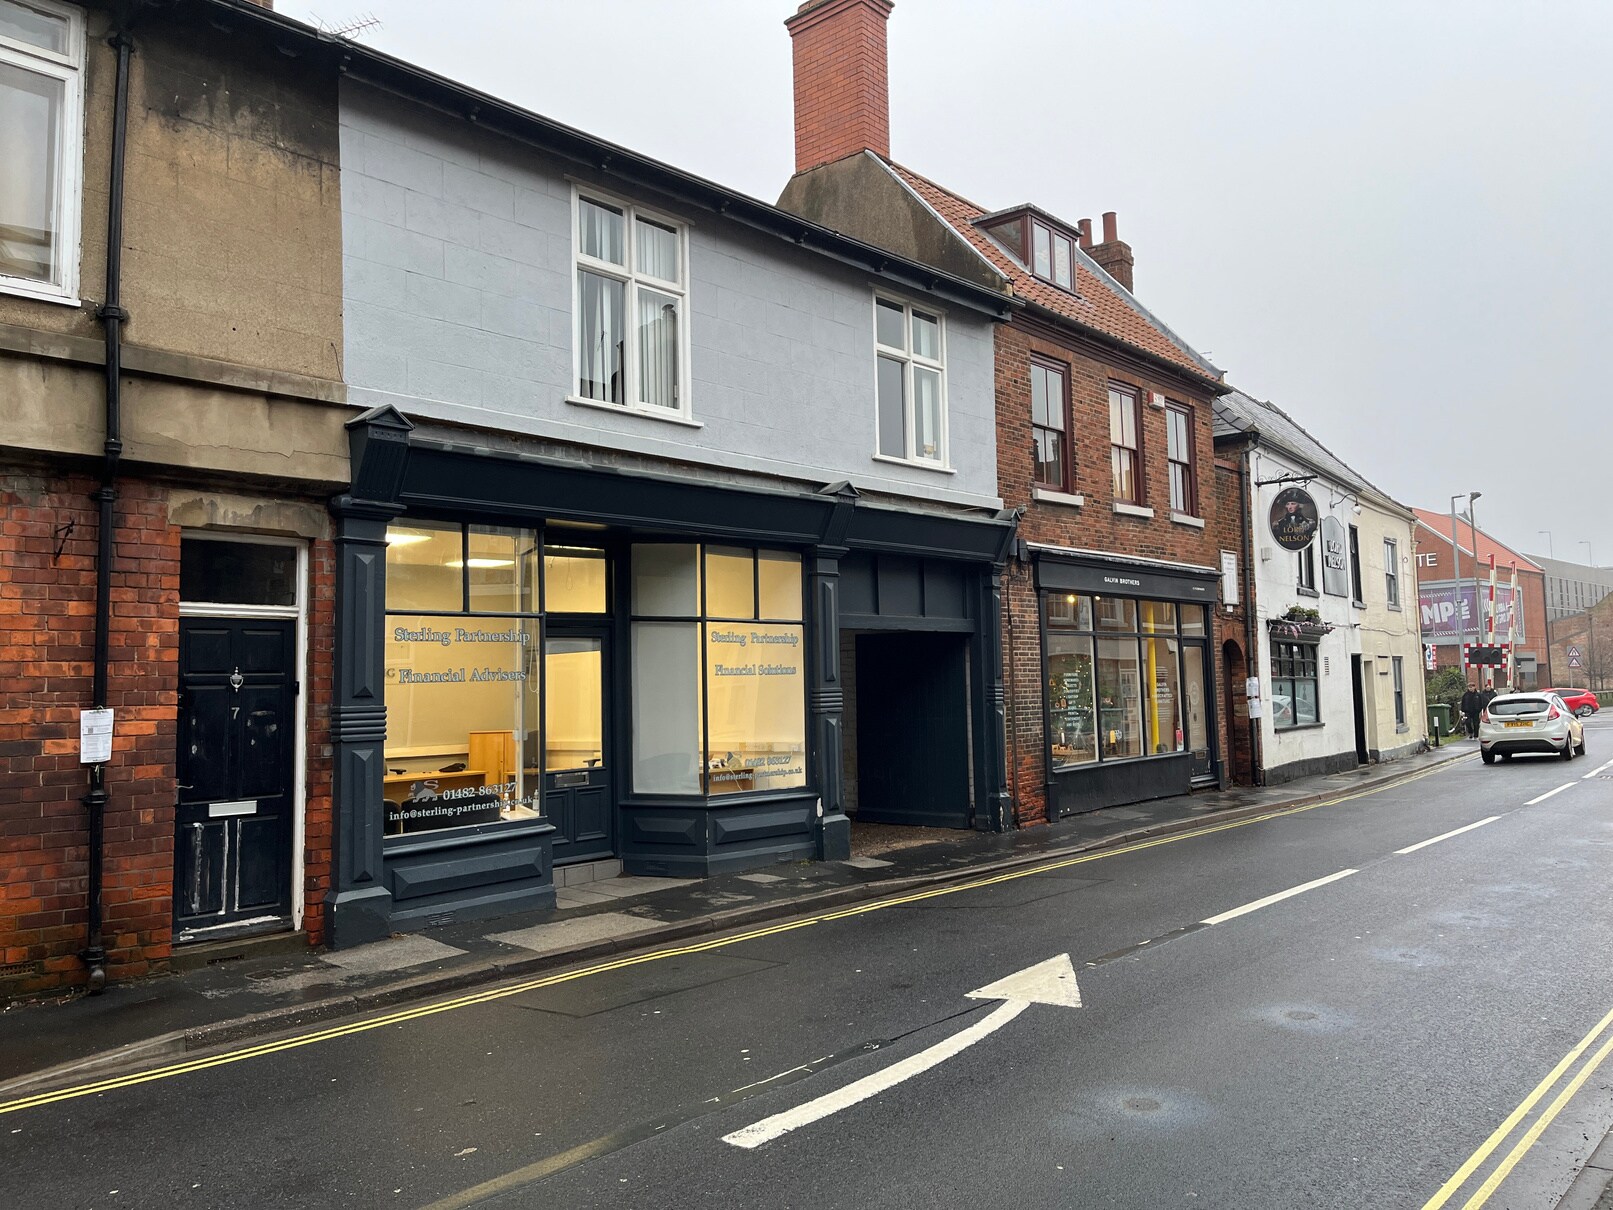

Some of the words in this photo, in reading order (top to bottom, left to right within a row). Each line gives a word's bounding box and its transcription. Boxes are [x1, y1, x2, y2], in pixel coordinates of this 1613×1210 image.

[1104, 576, 1119, 584] GALVIN
[1119, 578, 1140, 586] BROTHERS
[394, 627, 452, 646] Sterling
[455, 628, 531, 646] Partnership
[711, 631, 747, 647] Sterling
[750, 631, 799, 647] Partnership
[399, 668, 465, 684] Financial
[469, 668, 527, 682] Advisers
[714, 664, 756, 676] Financial
[758, 664, 797, 676] Solutions
[231, 706, 240, 720] 7
[442, 787, 476, 801] 01482
[478, 782, 517, 797] 863127
